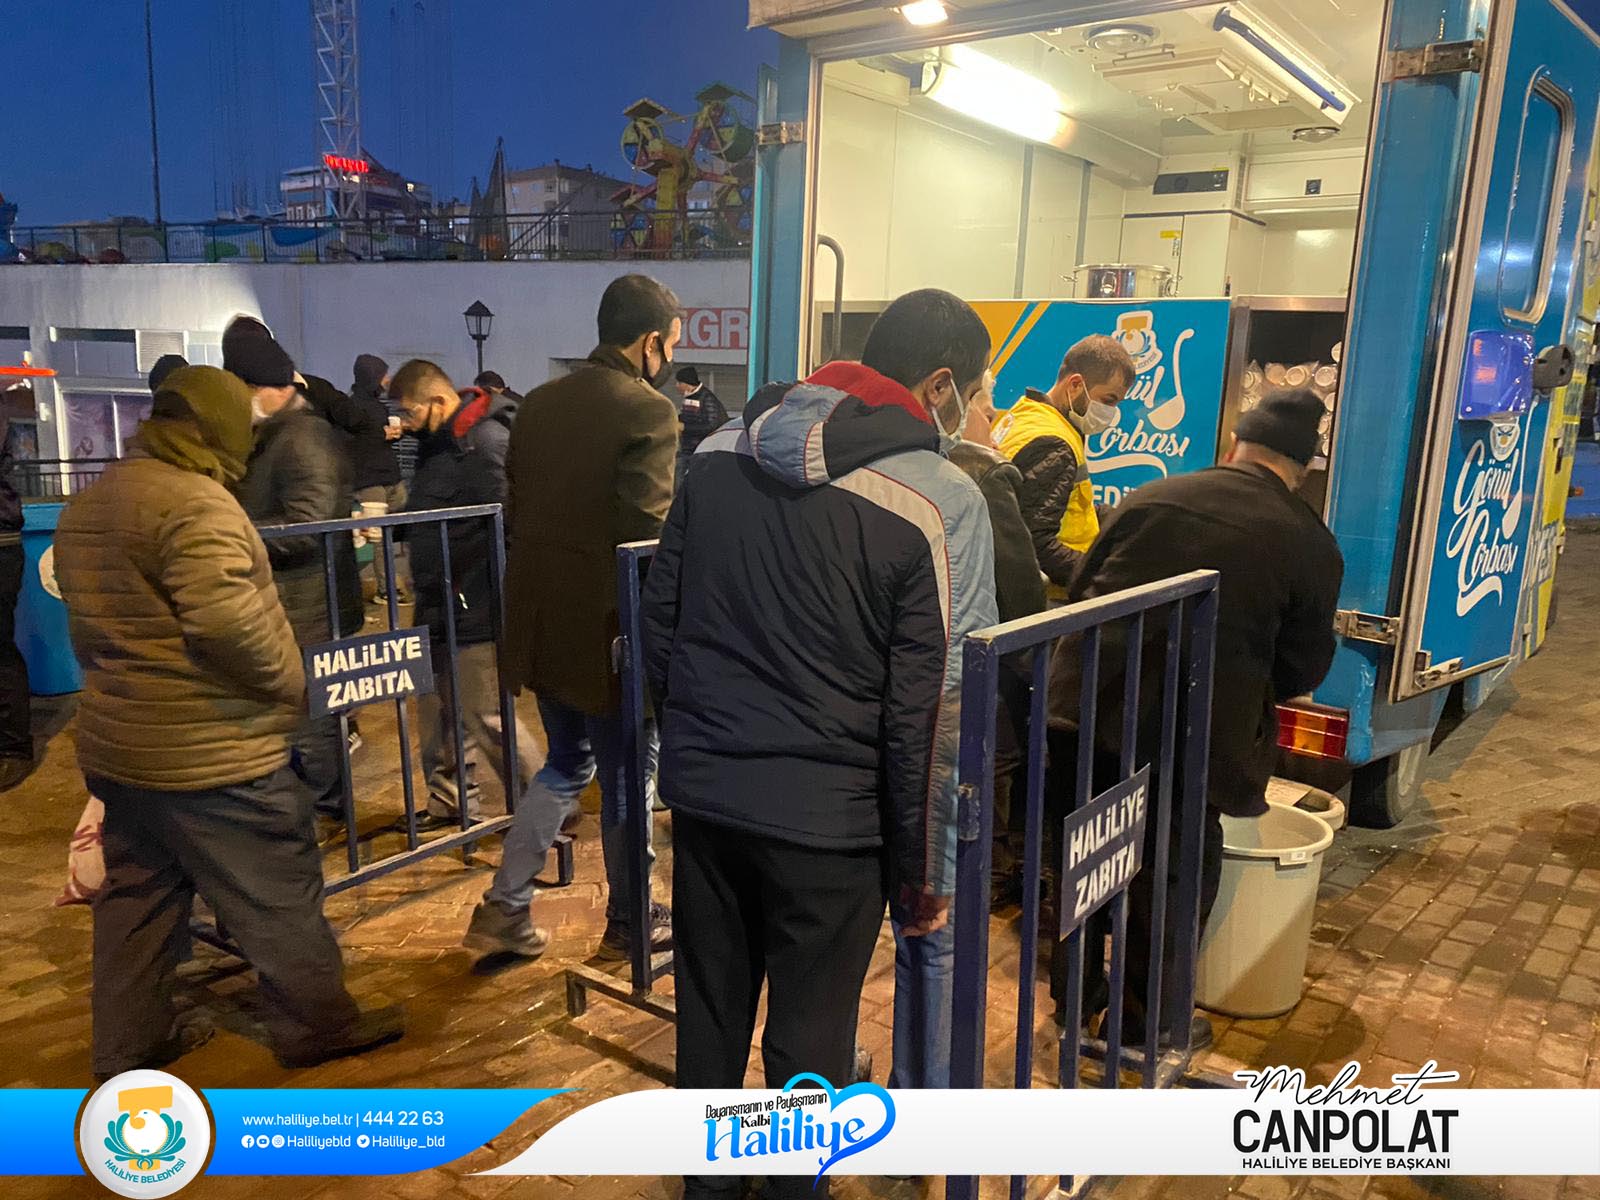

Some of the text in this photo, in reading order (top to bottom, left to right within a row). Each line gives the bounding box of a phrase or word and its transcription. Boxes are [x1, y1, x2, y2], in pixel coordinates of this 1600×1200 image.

[1446, 439, 1520, 558] Gönül
[326, 669, 415, 709] ZABITA
[1073, 840, 1136, 920] ZABITA
